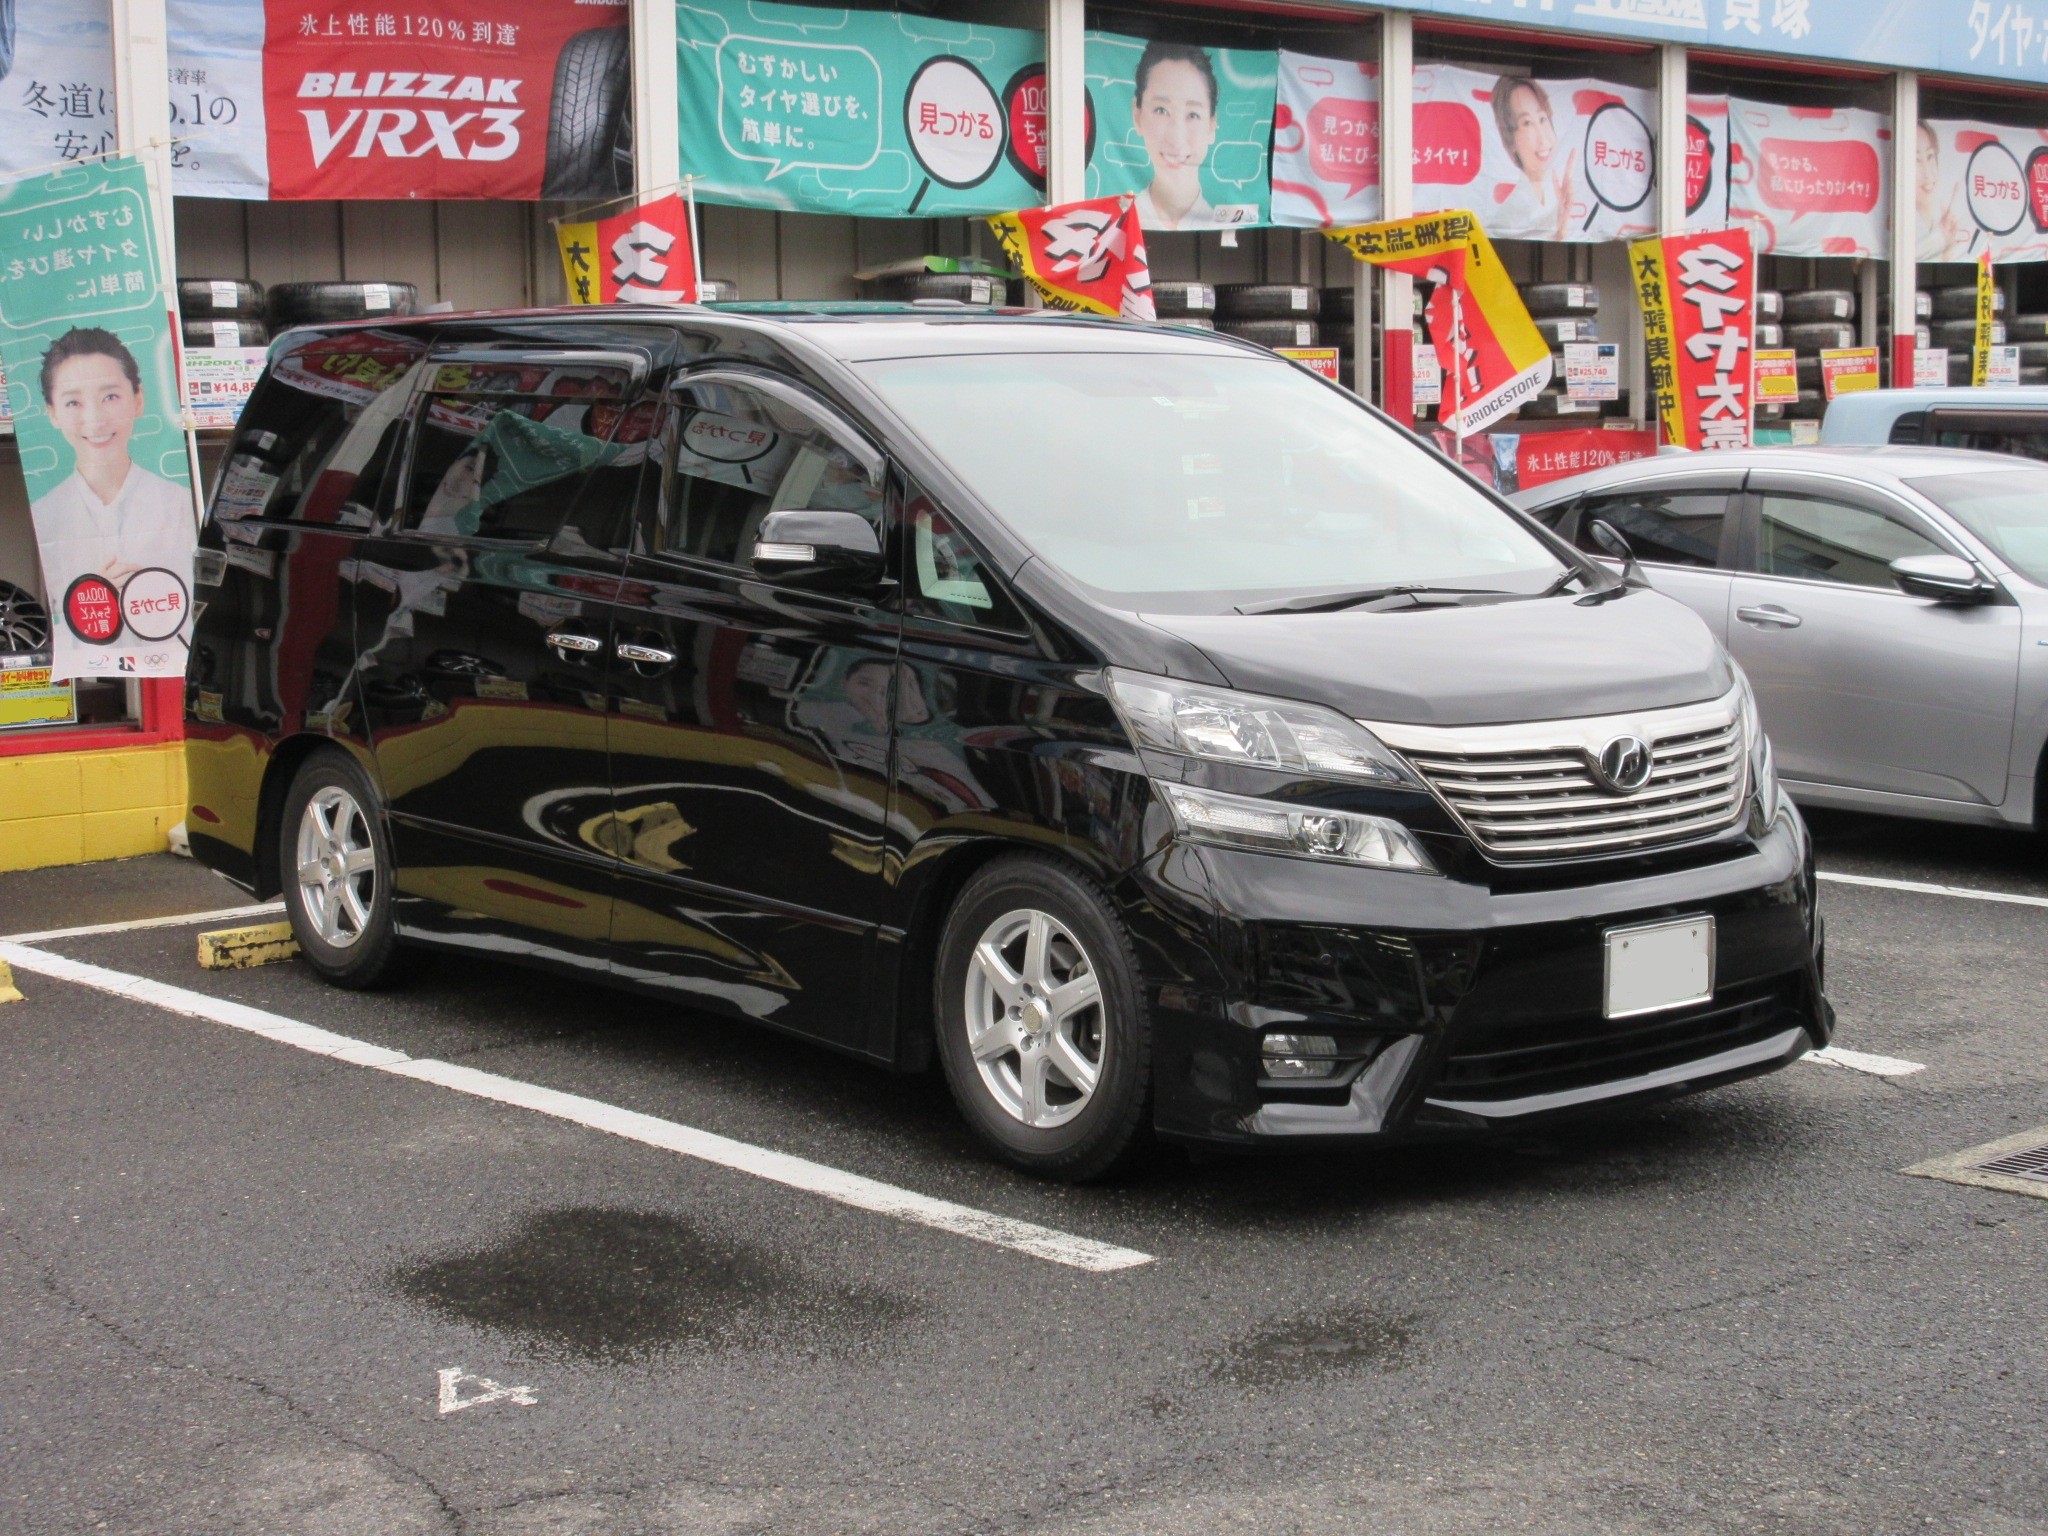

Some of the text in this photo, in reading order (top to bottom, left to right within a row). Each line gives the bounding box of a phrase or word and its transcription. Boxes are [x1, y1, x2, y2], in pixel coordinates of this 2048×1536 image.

[298, 13, 517, 46] 氷上性能120%到達
[1968, 0, 2048, 66] タイヤ・
[737, 51, 838, 82] むずかしい
[296, 72, 522, 103] BLIZZAK
[739, 85, 868, 121] タイヤ選びを、
[740, 117, 815, 150] 簡単に。
[919, 102, 994, 140] 見つかる
[297, 107, 526, 169] VRX3
[1594, 141, 1646, 173] 見つかる
[1974, 175, 2020, 200] 見つかる
[1462, 371, 1542, 429] BRIDGESTONE
